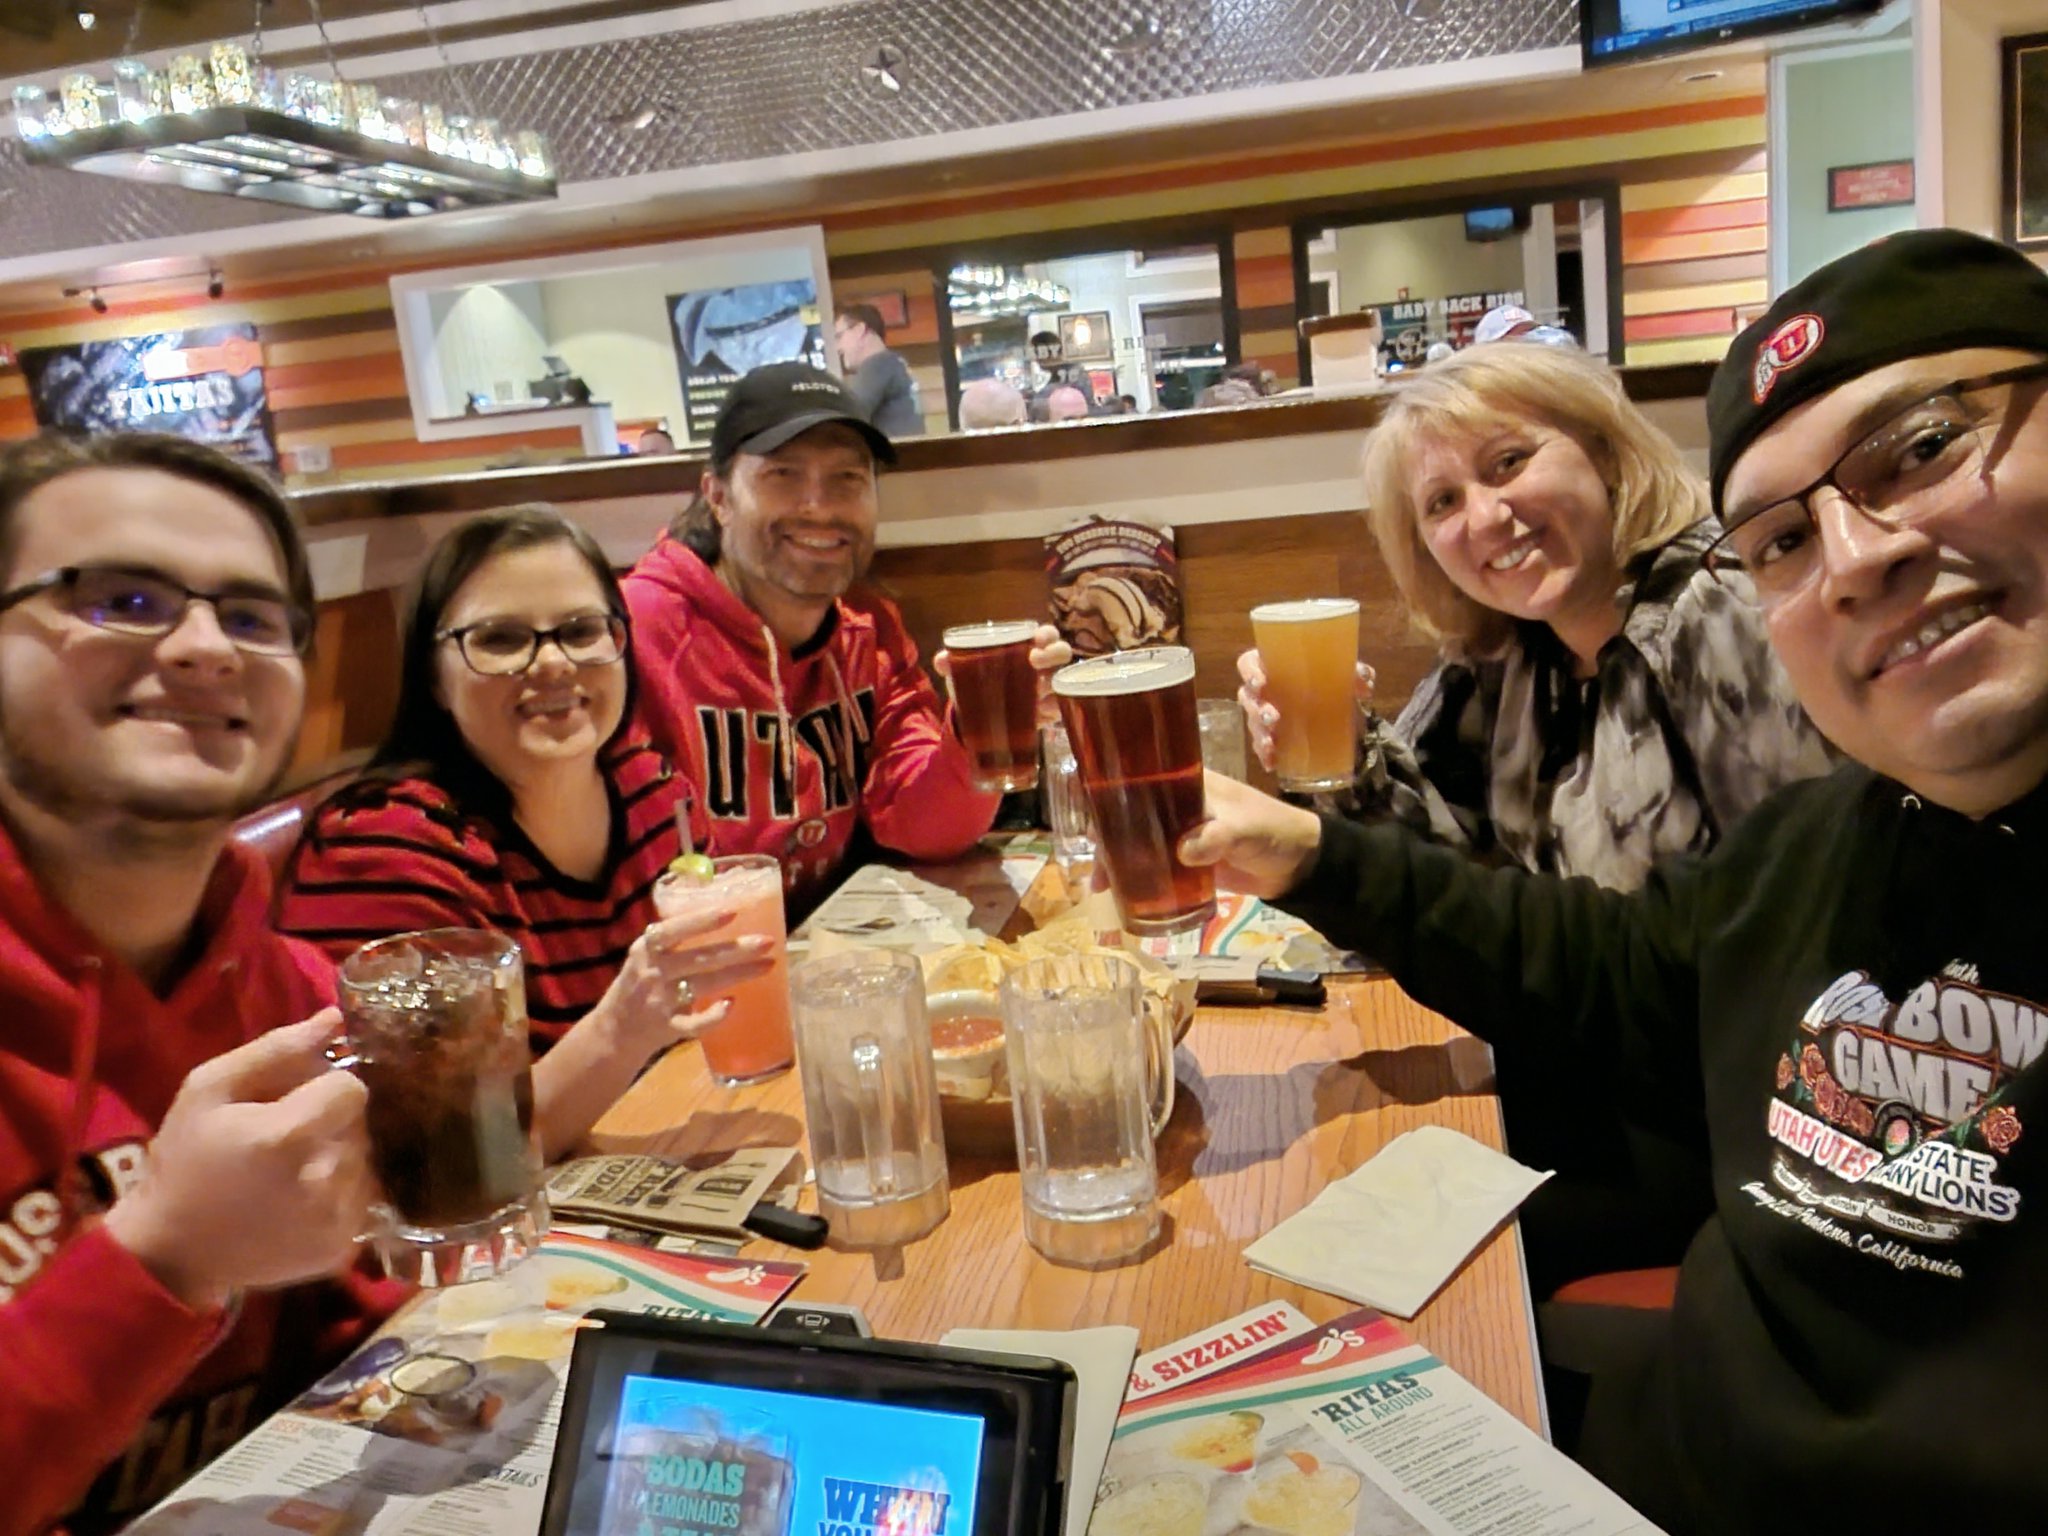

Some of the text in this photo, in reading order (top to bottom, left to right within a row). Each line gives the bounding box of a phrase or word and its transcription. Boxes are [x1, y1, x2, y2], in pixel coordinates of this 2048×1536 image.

[107, 377, 235, 419] FAJITAS
[1894, 980, 2048, 1071] BOW
[1769, 1101, 1818, 1153] UTAH
[1820, 1123, 1878, 1179] UTES
[1913, 1145, 1990, 1184] STATE
[1921, 1174, 2012, 1217] LIONS
[1886, 1213, 1936, 1234] HONOR
[1857, 1233, 1964, 1279] California
[1152, 1310, 1287, 1382] SIZZLIN'
[1337, 1414, 1370, 1436] ALL
[1373, 1386, 1434, 1421] AROUND
[646, 1455, 745, 1498] SODAS
